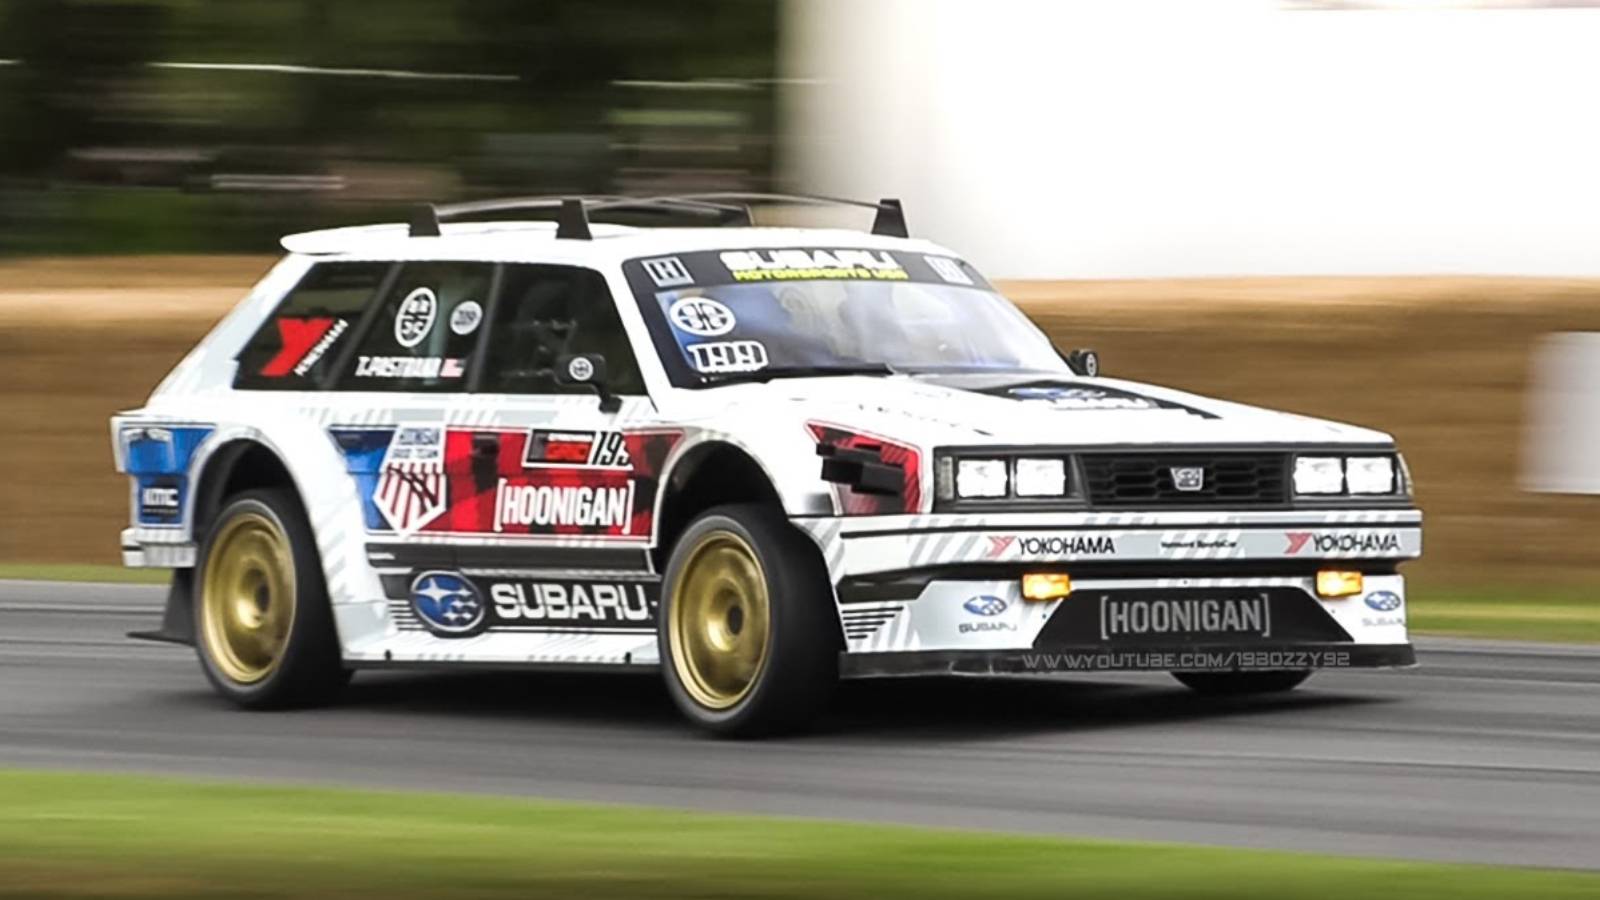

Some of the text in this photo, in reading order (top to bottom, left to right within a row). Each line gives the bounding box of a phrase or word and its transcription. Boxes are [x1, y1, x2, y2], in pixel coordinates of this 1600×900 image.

[720, 250, 898, 270] SUBARU
[1020, 537, 1115, 554] YOKOHAMA
[1313, 533, 1400, 551] YOKOHAMA
[491, 584, 649, 620] SUBARU
